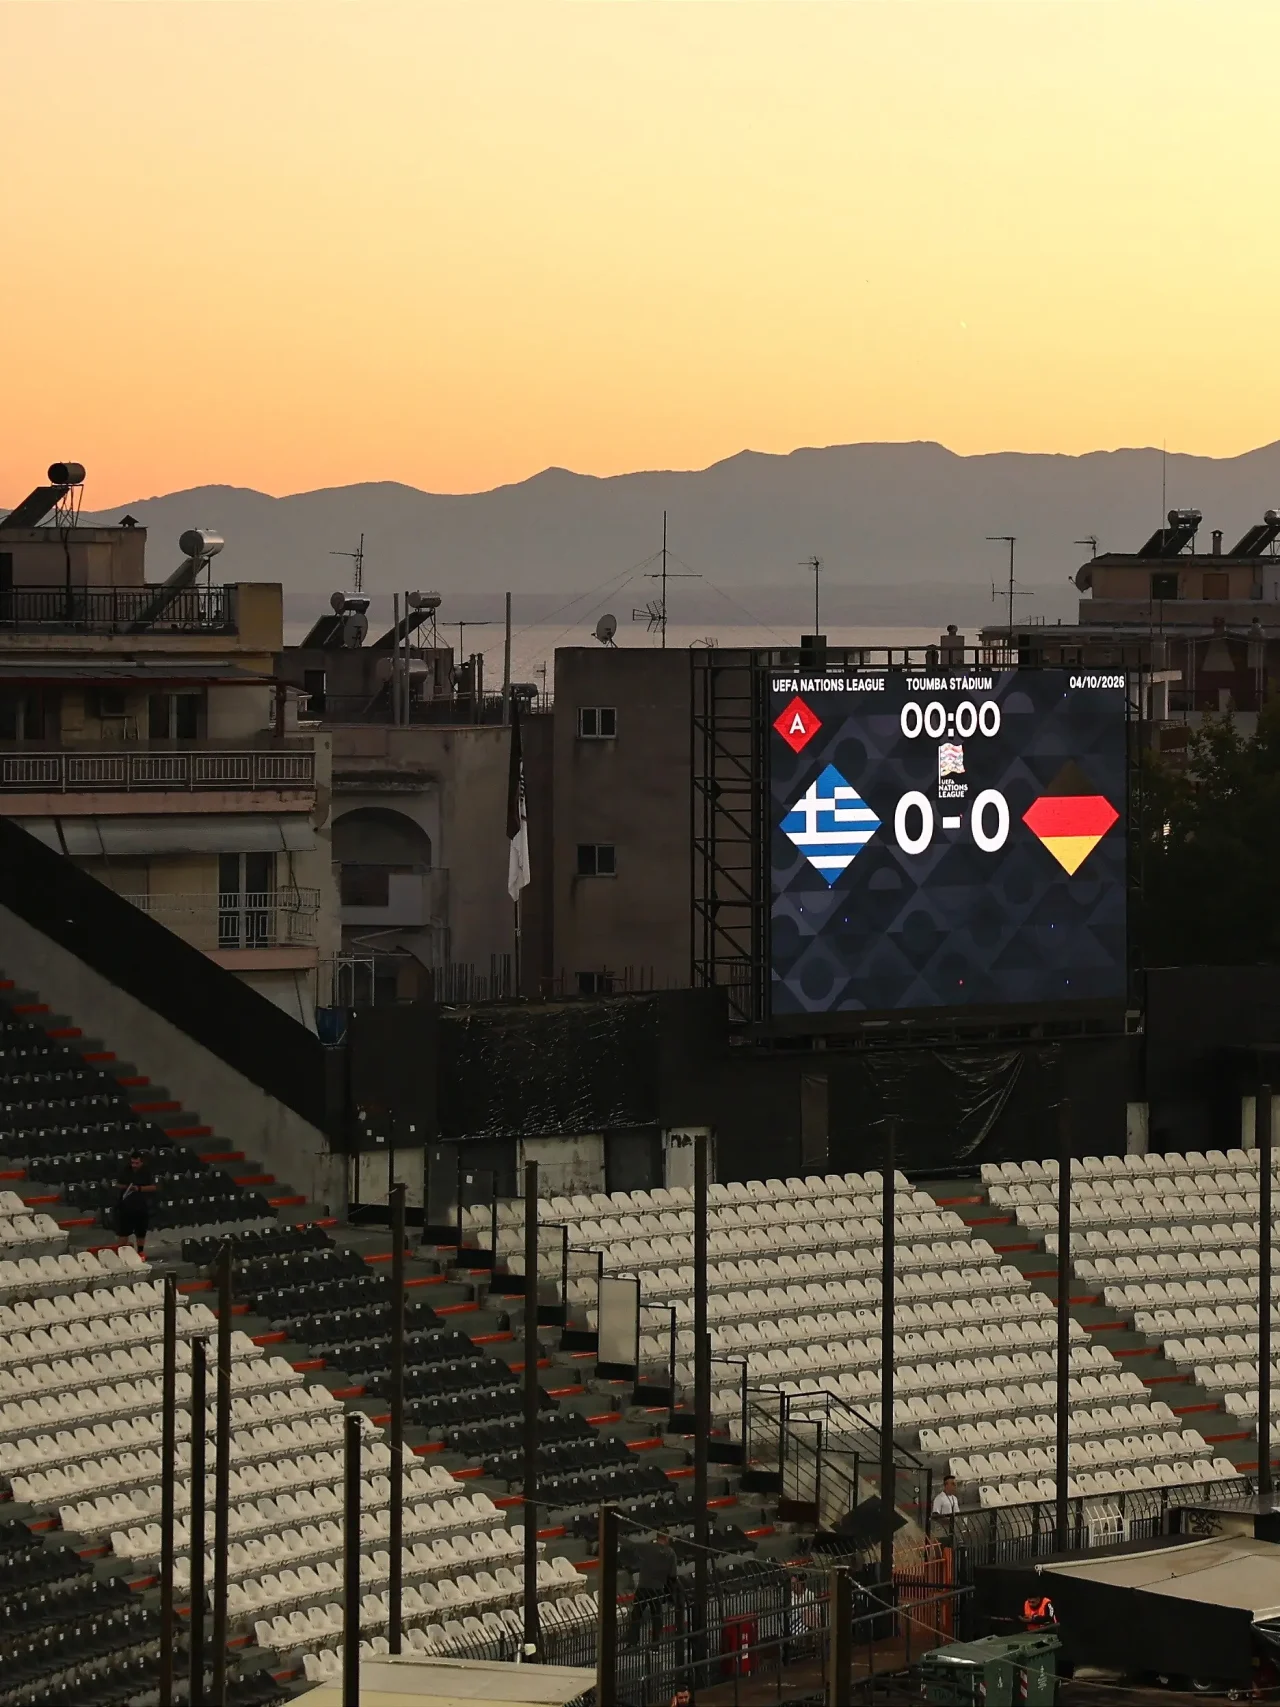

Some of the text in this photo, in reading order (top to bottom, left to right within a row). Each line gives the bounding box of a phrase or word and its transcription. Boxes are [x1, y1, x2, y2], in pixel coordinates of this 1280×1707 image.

[772, 678, 885, 692] UEFA NATIONS LEAGUE
[906, 676, 992, 691] TOUMBA STADIUM
[1069, 675, 1125, 689] 04/10/2026
[788, 713, 806, 734] A
[900, 700, 1001, 739] 00:00
